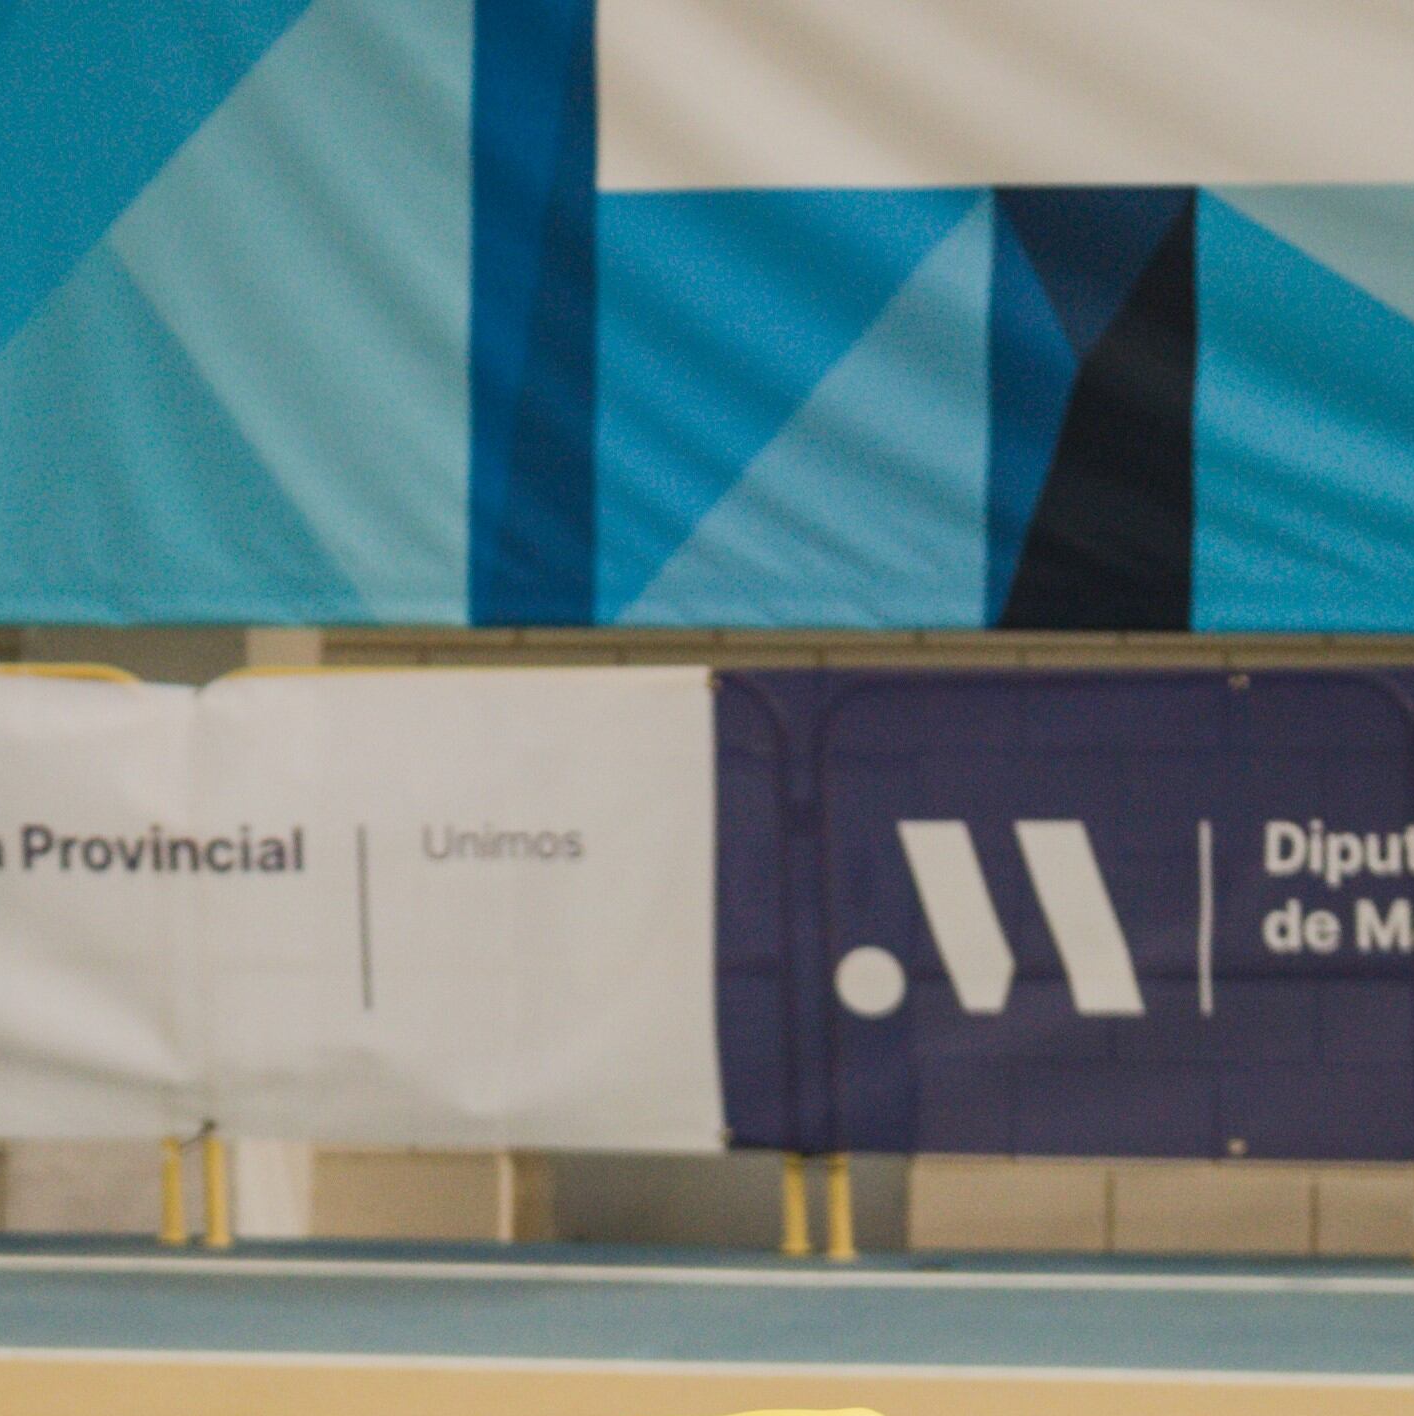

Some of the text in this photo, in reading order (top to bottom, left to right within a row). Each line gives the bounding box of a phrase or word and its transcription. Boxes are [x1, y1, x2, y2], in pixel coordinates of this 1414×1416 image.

[21, 823, 305, 874] Provincial
[423, 823, 583, 864] Unimos
[1263, 899, 1341, 953] de
